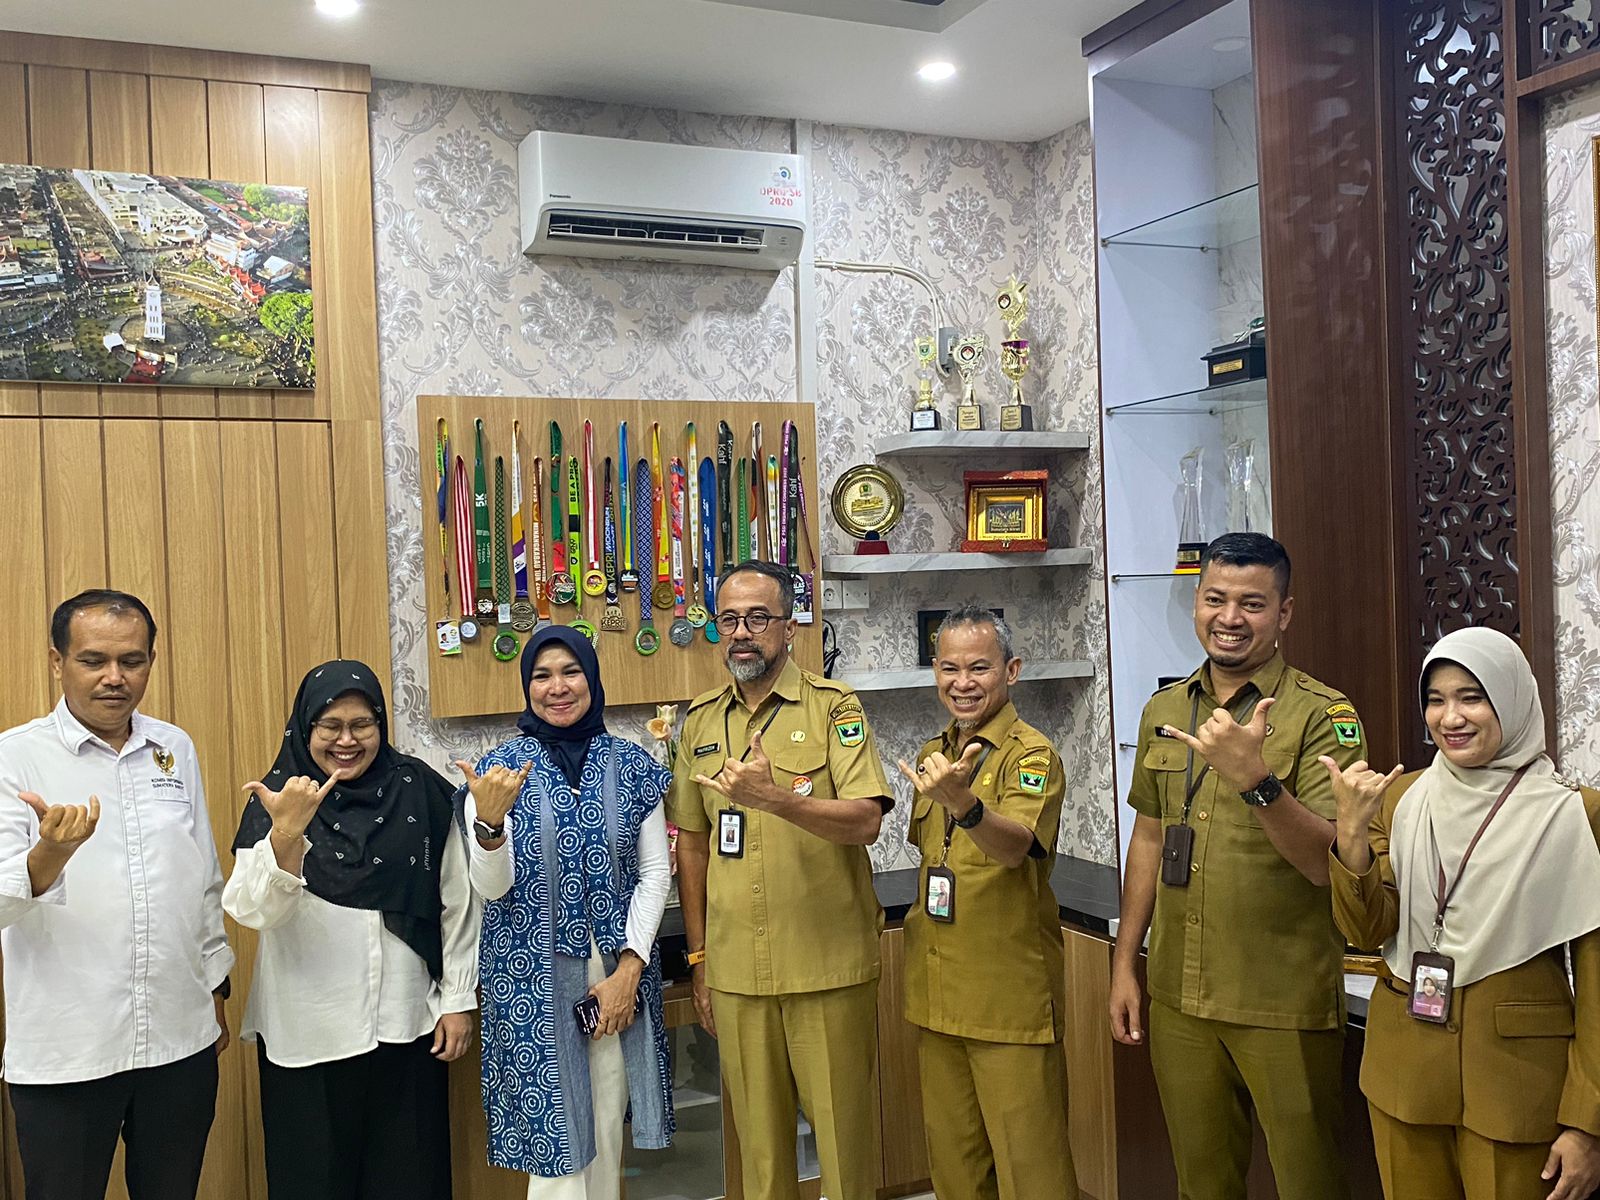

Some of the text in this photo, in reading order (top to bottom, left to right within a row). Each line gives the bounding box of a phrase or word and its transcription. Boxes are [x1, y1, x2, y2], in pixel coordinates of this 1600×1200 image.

[769, 196, 793, 207] 2020
[717, 443, 727, 465] Kahf
[570, 491, 577, 502] BE
[788, 477, 798, 498] Kahf
[475, 492, 485, 507] 5K
[606, 552, 615, 581] KEPRI
